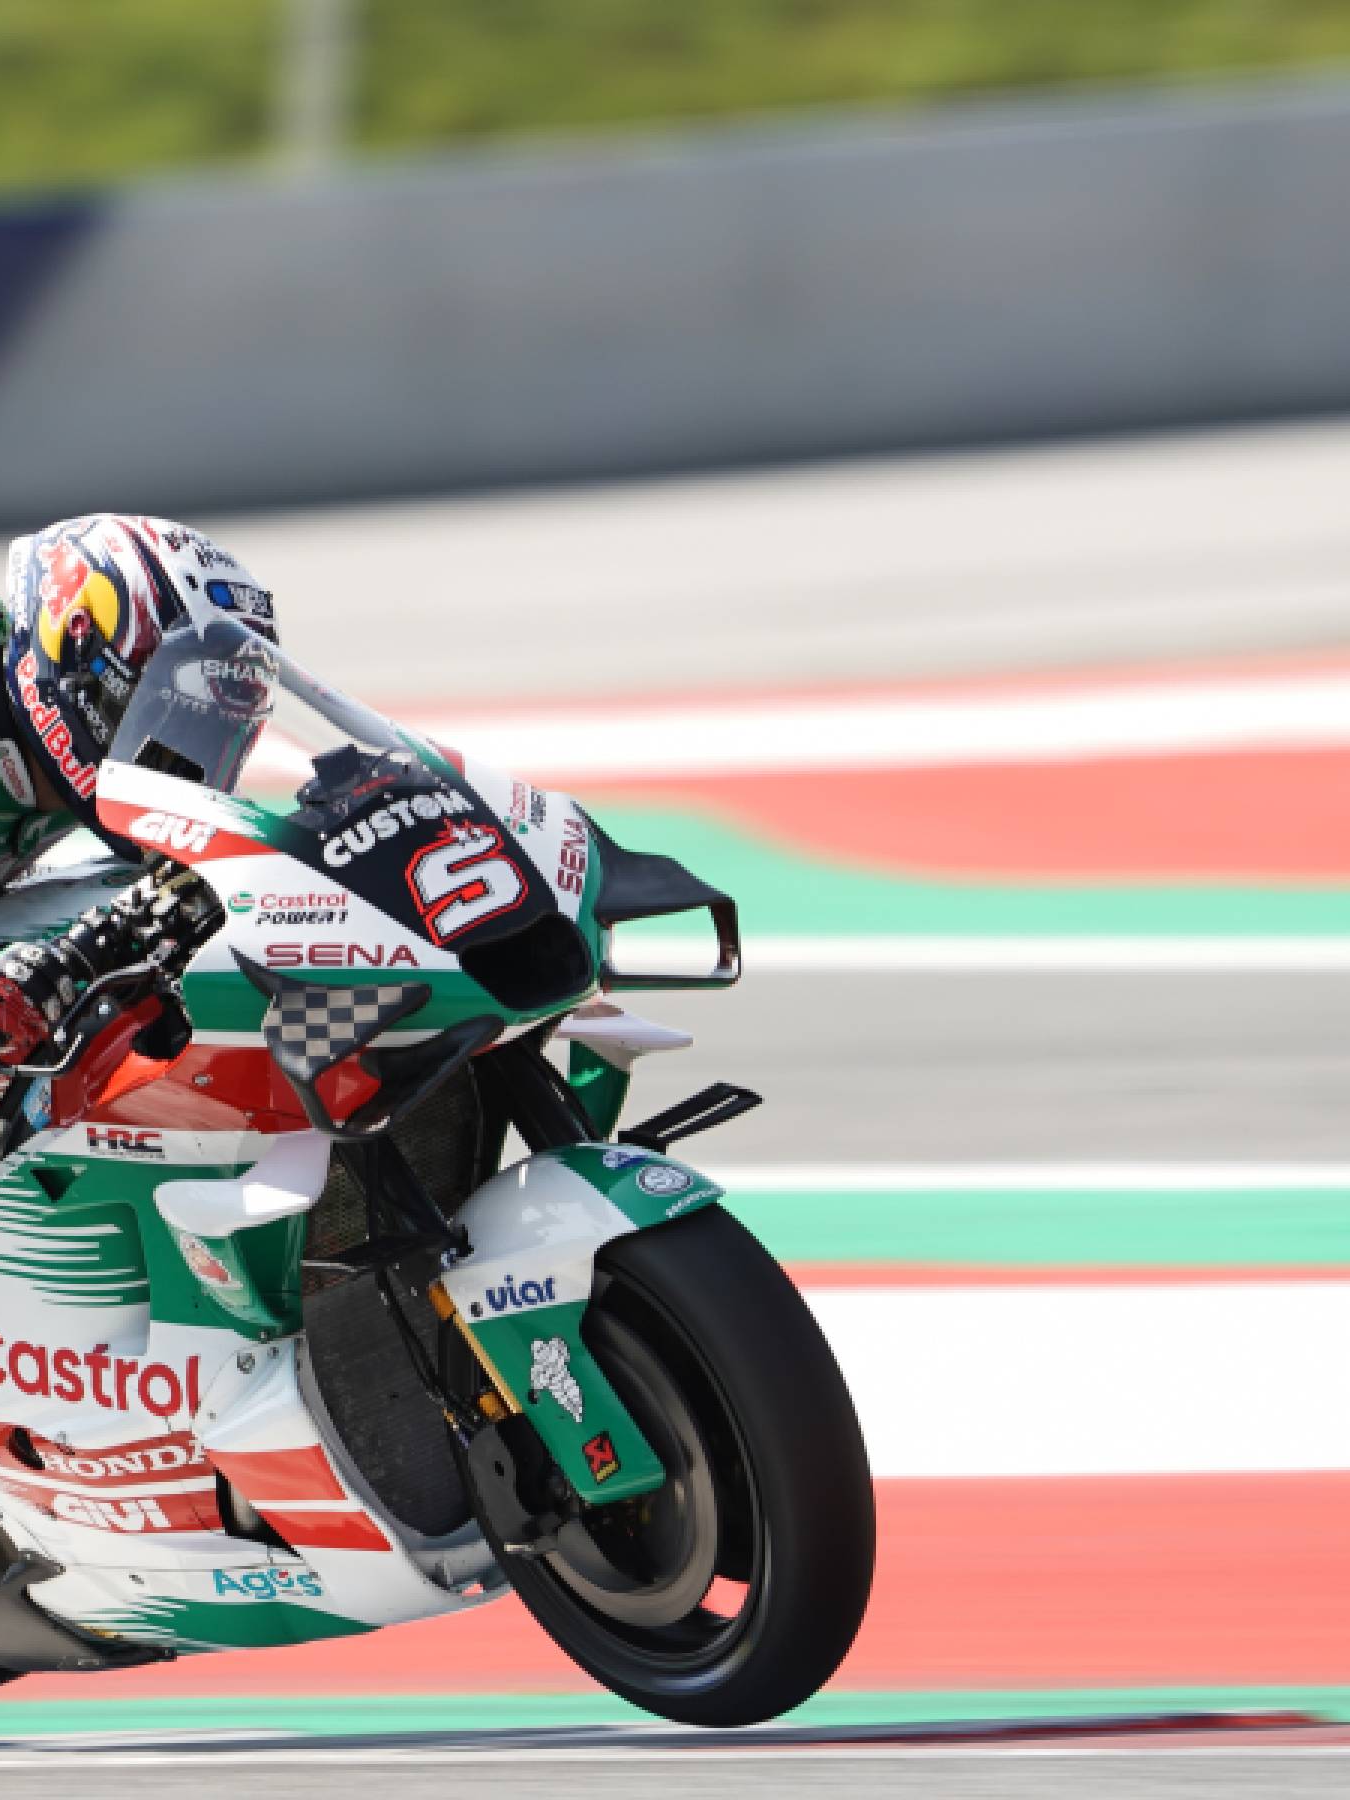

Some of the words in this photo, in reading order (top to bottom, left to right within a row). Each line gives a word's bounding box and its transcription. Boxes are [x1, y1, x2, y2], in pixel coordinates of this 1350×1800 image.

[43, 719, 98, 799] Bull
[128, 811, 217, 853] GIVI
[322, 789, 474, 868] CUSTOM
[557, 818, 588, 896] SENA
[259, 891, 349, 911] Castrol
[263, 942, 421, 968] SENA
[86, 1126, 163, 1153] HRC
[51, 1494, 172, 1531] GIVI
